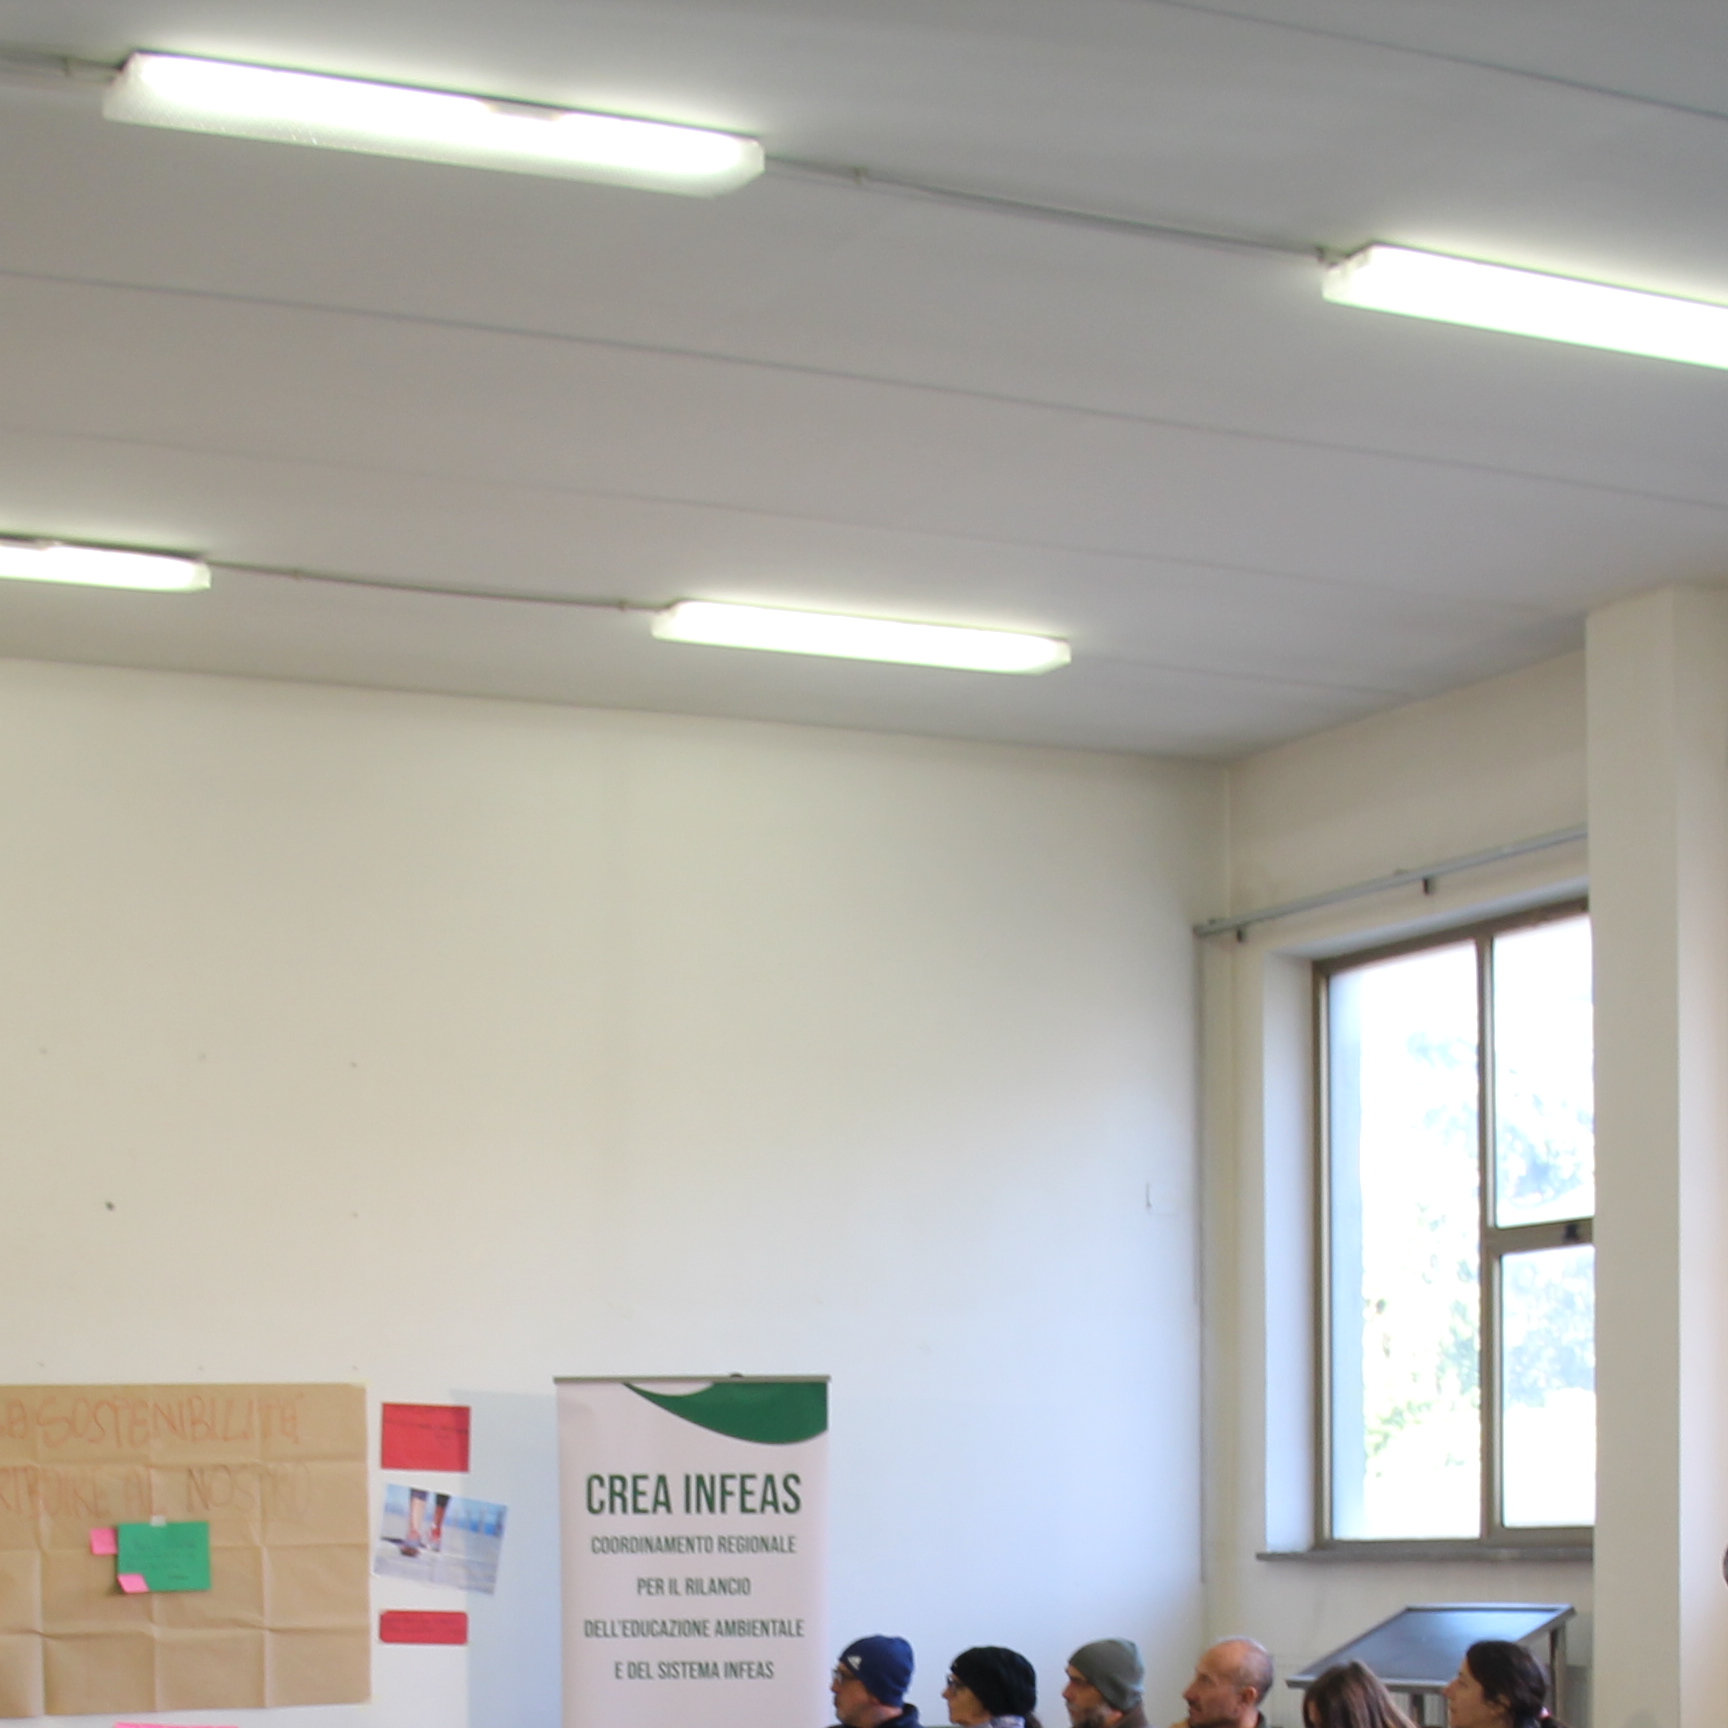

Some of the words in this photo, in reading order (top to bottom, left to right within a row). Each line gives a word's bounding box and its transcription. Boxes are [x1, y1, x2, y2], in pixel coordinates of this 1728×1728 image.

[586, 1473, 671, 1515] CREA
[684, 1473, 802, 1515] INFEAS
[591, 1535, 714, 1555] COORDINAMENTO
[717, 1535, 797, 1554] REGIONALE
[637, 1577, 666, 1596] PER
[669, 1577, 682, 1595] IL
[685, 1577, 751, 1595] RILANCIO
[584, 1619, 711, 1638] DELL'EDUCAZIONE
[714, 1619, 804, 1637] AMBIENTALE
[614, 1661, 624, 1680] E
[627, 1661, 652, 1680] DEL
[657, 1661, 720, 1680] SISTEMA
[723, 1661, 774, 1680] INFEAS
